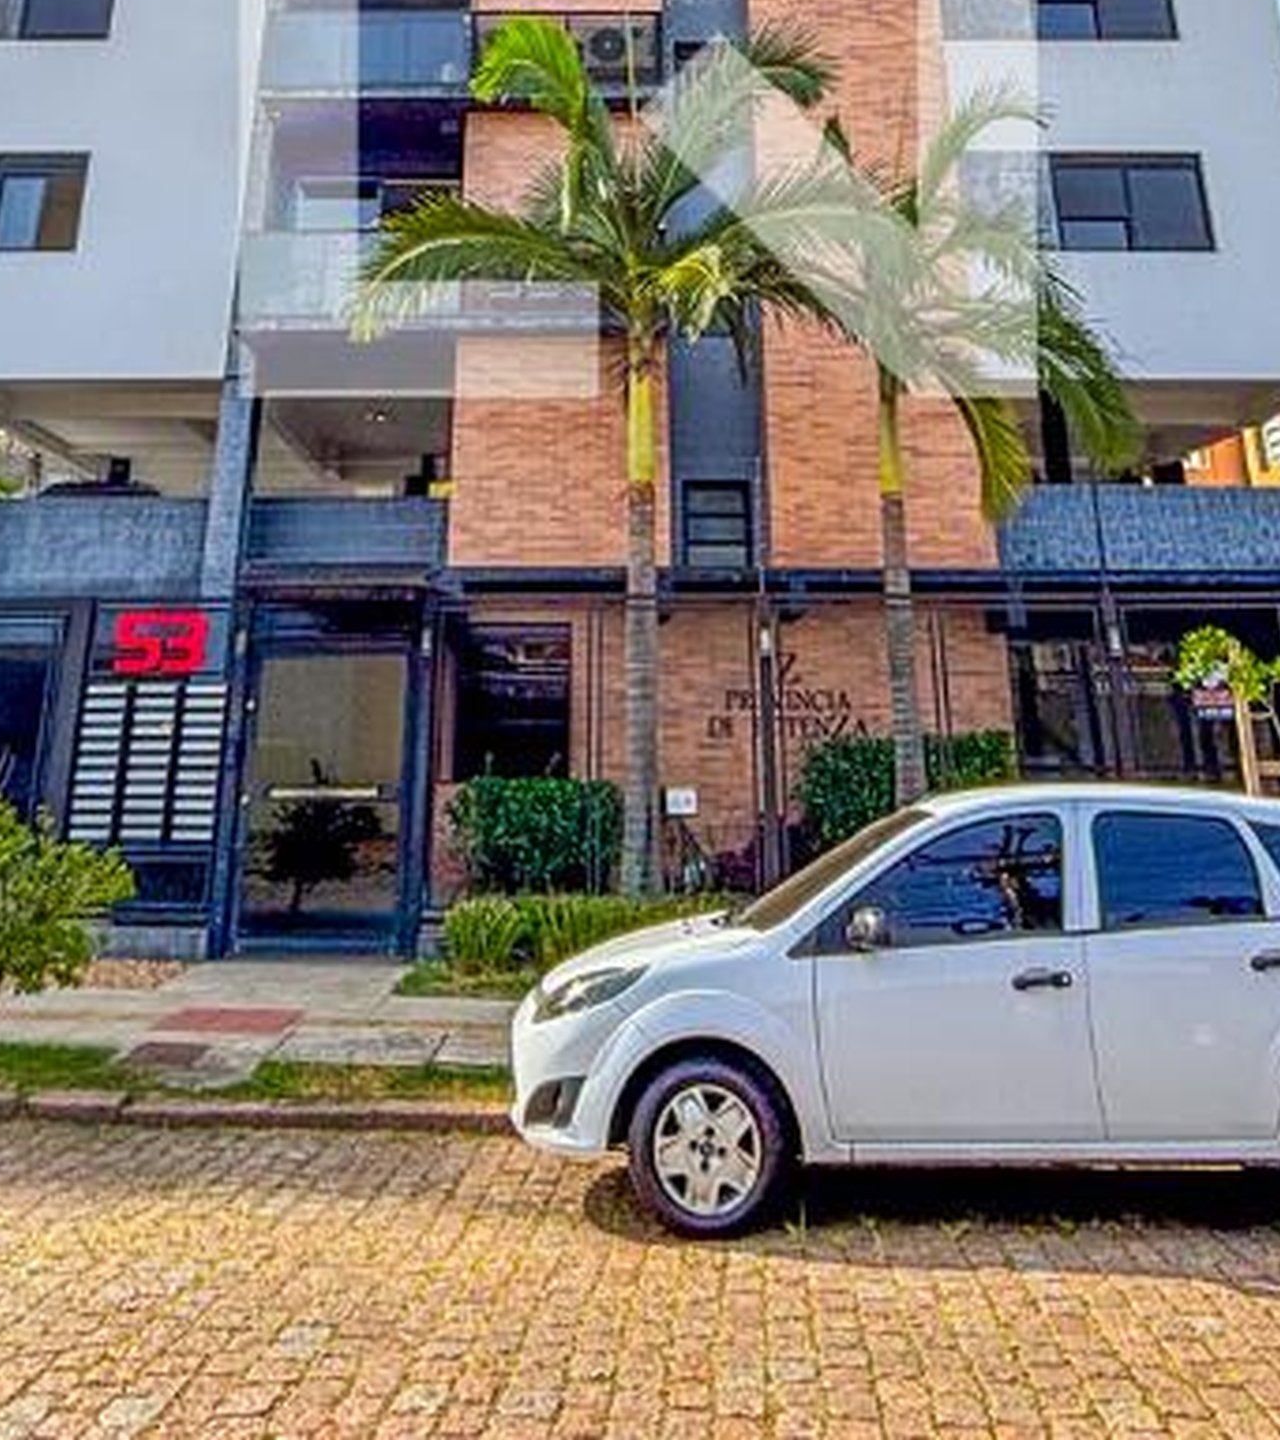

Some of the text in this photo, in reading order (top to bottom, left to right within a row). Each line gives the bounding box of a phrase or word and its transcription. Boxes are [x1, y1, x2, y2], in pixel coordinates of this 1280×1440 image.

[112, 610, 208, 675] 53
[724, 690, 852, 717] PRINCIA
[751, 714, 869, 746] TENZA
